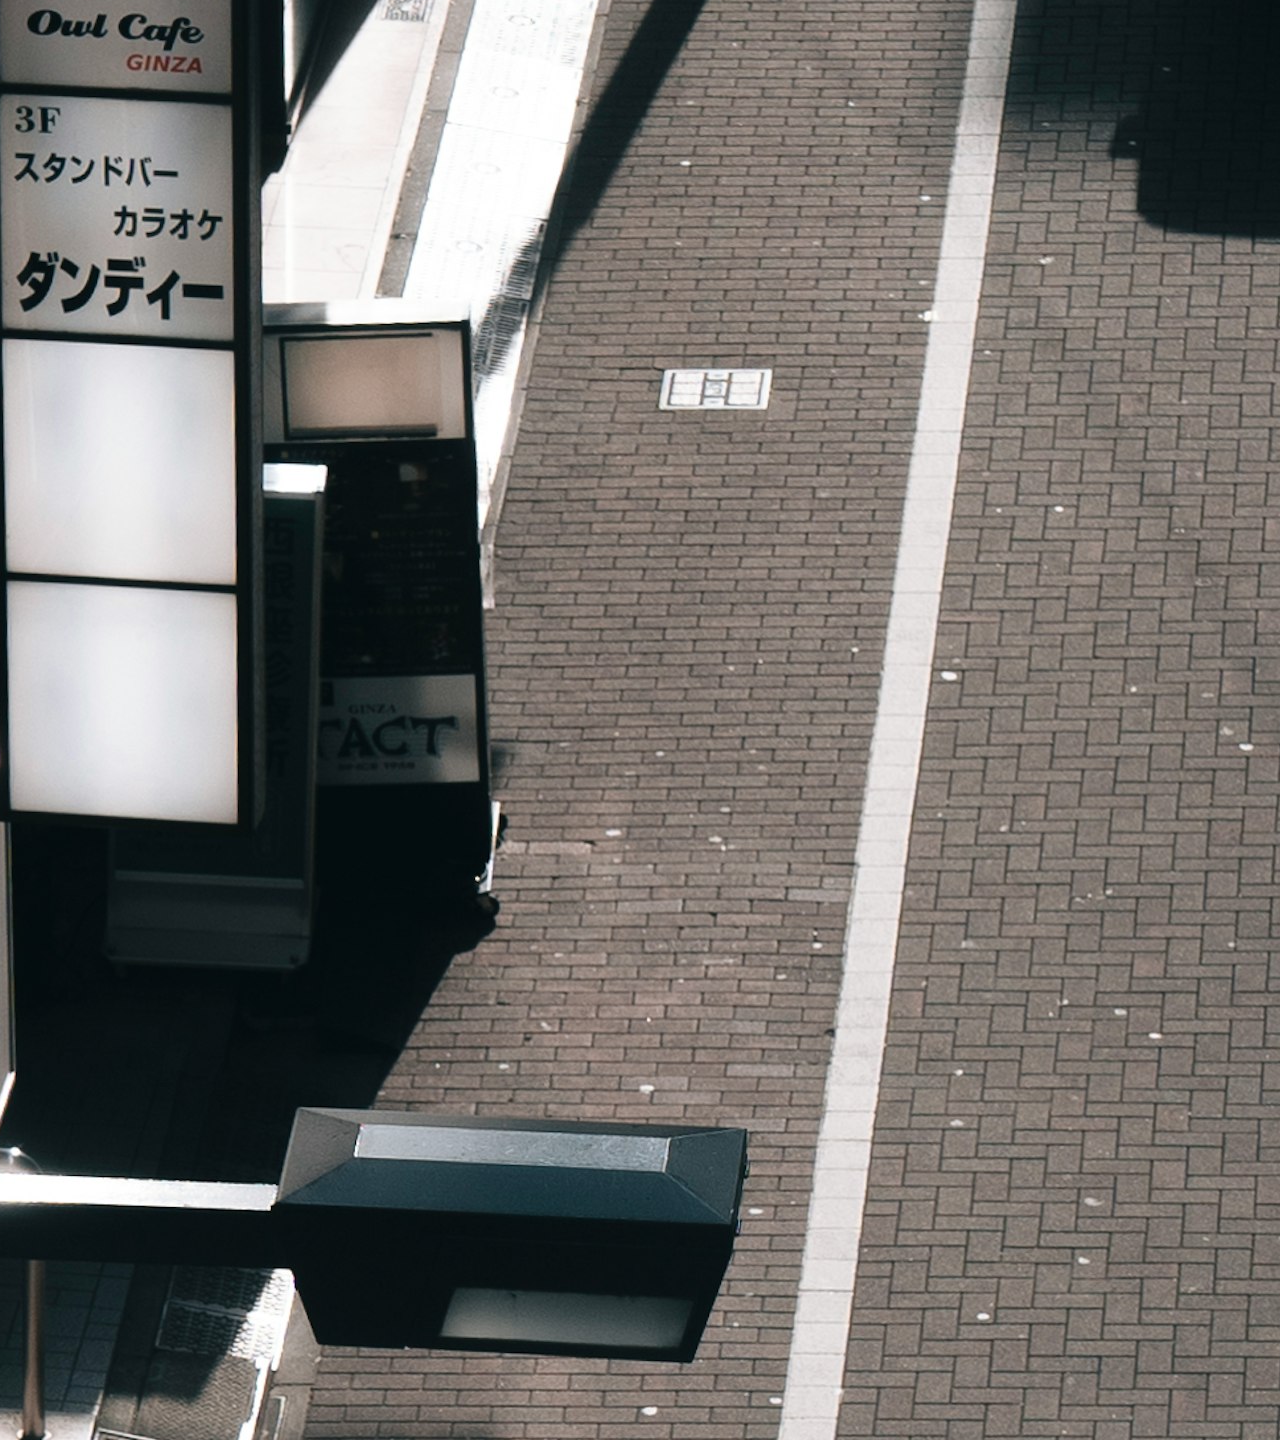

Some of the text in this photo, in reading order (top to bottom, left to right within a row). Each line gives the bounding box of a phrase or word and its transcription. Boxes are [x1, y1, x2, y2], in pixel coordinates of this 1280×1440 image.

[26, 8, 205, 49] Owl Cafe
[125, 53, 204, 76] GINZA
[14, 105, 62, 135] 3F
[13, 150, 180, 189] スタンドバー
[112, 203, 225, 242] カラオケ
[16, 249, 225, 320] ダンディー
[348, 703, 398, 715] GINZA
